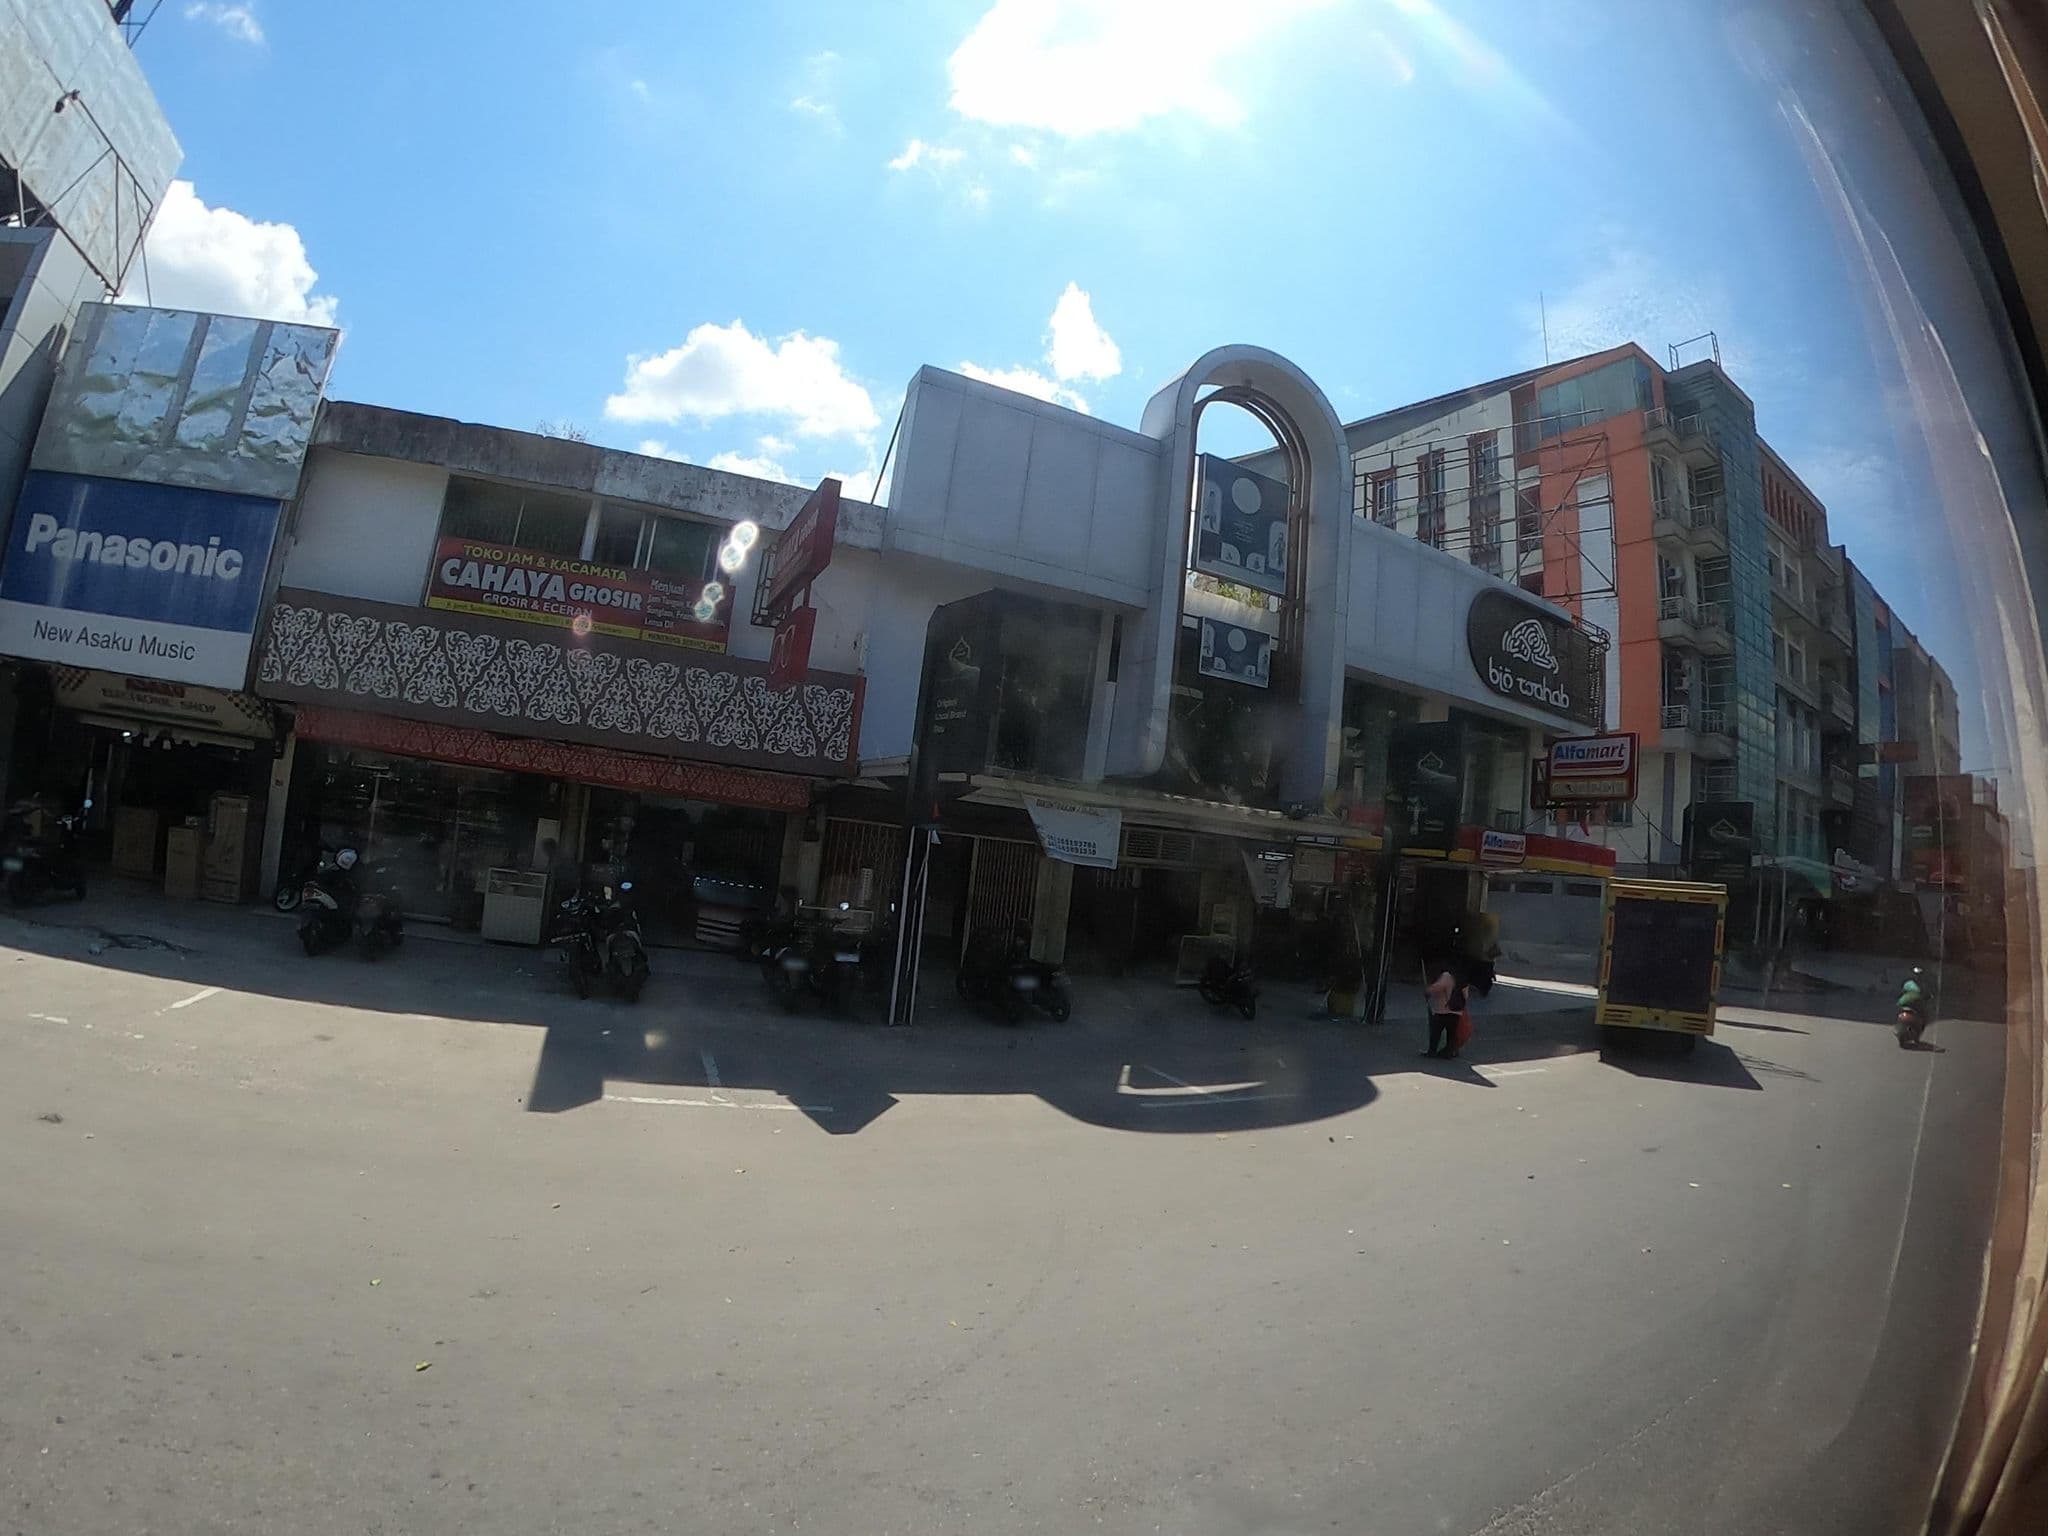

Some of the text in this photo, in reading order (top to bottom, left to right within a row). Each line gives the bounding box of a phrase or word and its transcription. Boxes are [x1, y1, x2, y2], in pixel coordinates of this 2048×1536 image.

[25, 513, 243, 581] Panasonic
[464, 544, 628, 581] TOKO JAM & KACAMATA
[441, 558, 642, 611] CAHAYA GROSIR
[482, 592, 528, 609] GROSIR
[530, 600, 540, 611] &
[543, 602, 593, 618] ECERAN
[33, 619, 196, 661] New Asaku Music
[1553, 743, 1625, 760] Alfamart
